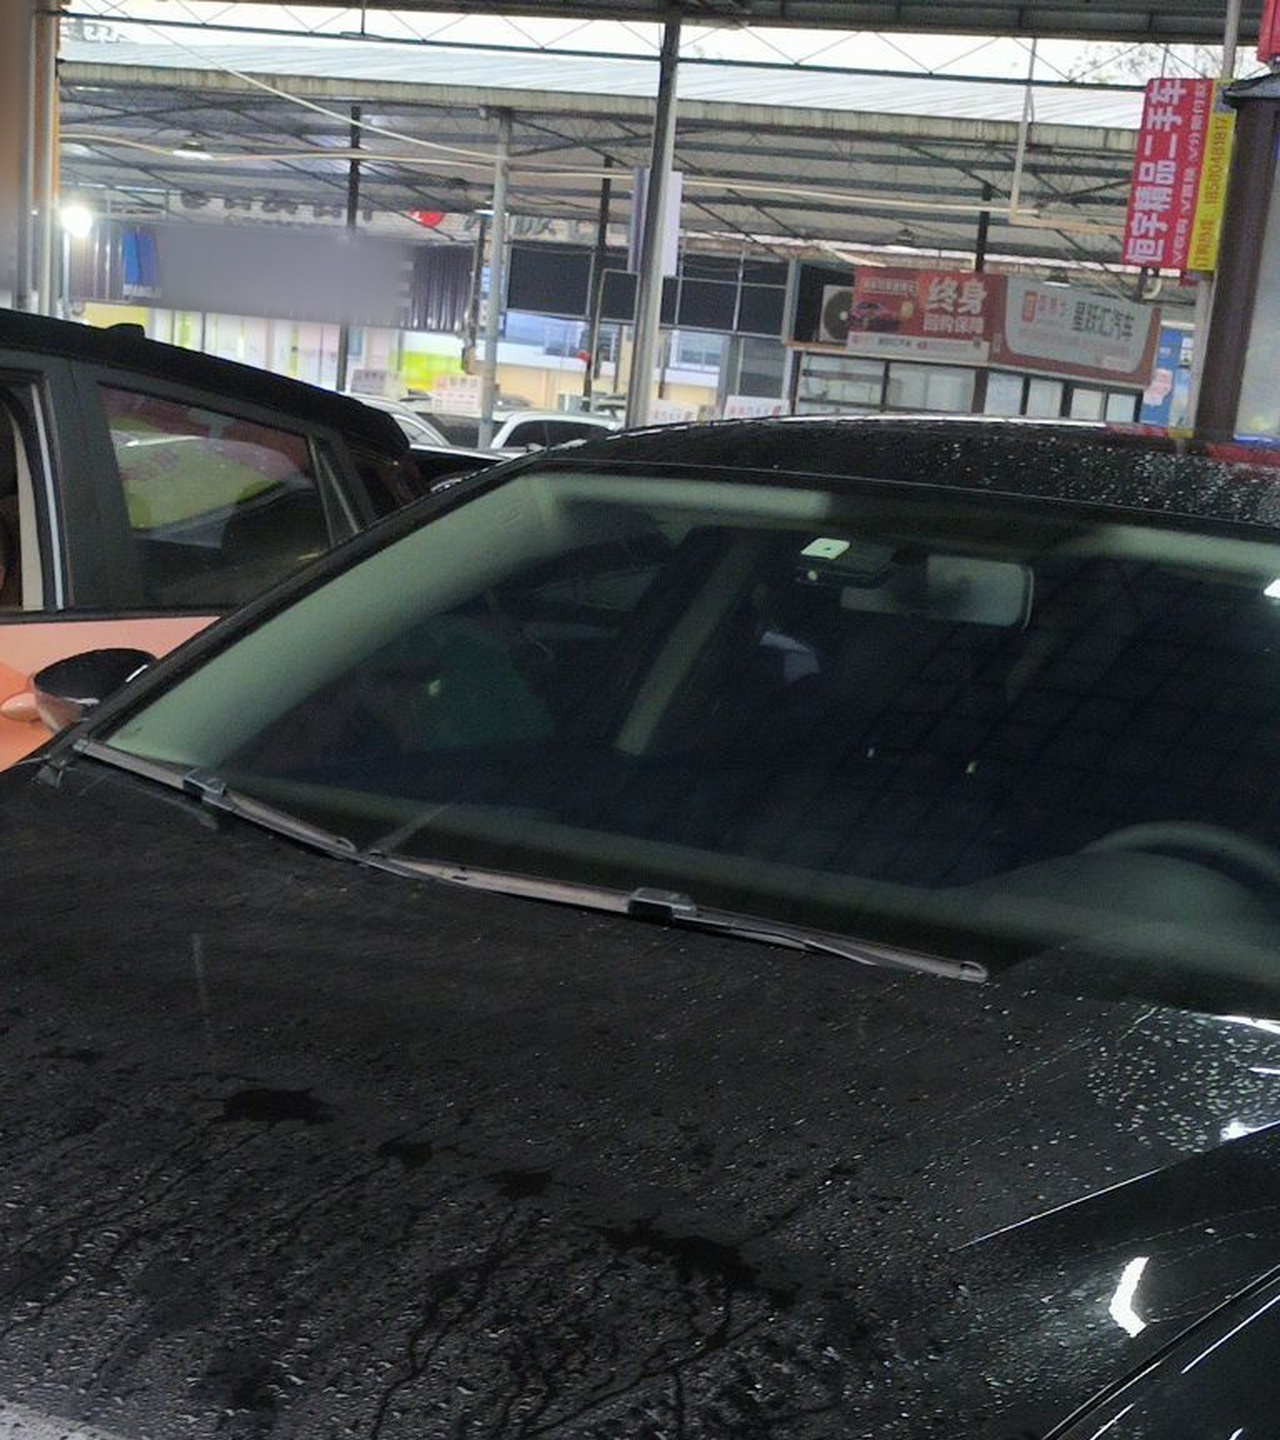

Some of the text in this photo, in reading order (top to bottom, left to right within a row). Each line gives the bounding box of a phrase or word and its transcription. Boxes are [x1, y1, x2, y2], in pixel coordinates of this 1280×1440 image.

[1128, 80, 1186, 264] 恒宇精品二手车
[927, 276, 988, 314] 终身
